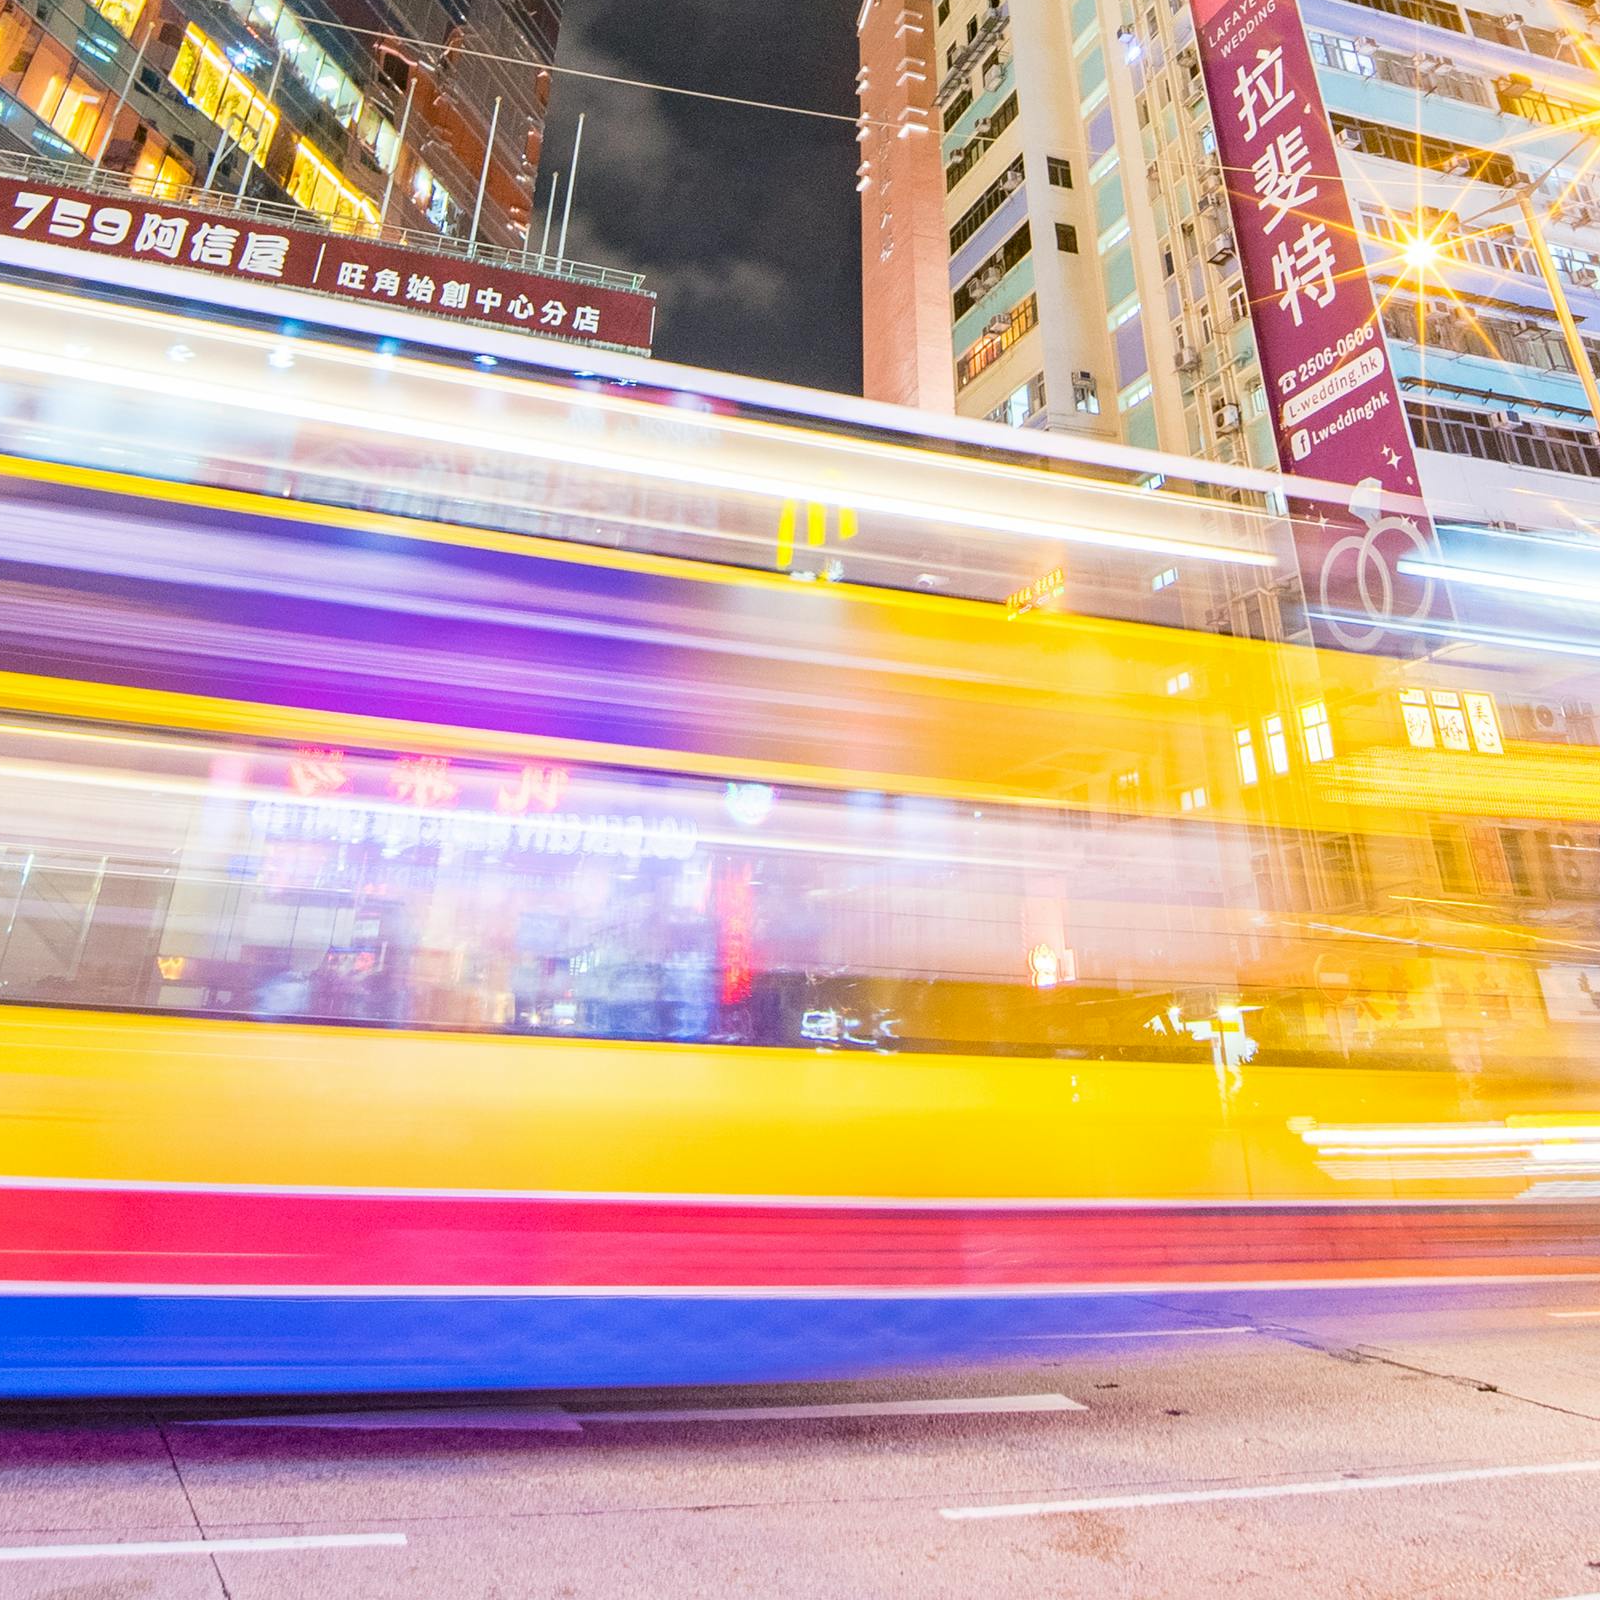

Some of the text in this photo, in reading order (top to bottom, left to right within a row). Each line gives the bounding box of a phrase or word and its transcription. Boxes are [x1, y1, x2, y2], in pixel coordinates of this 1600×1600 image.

[12, 191, 290, 277] 759阿信屋
[337, 261, 600, 333] 旺角始創中心分店
[1298, 323, 1374, 382] 2506-0606
[1289, 355, 1378, 418] L-wedding.hk
[1311, 391, 1390, 445] Lweddinghk
